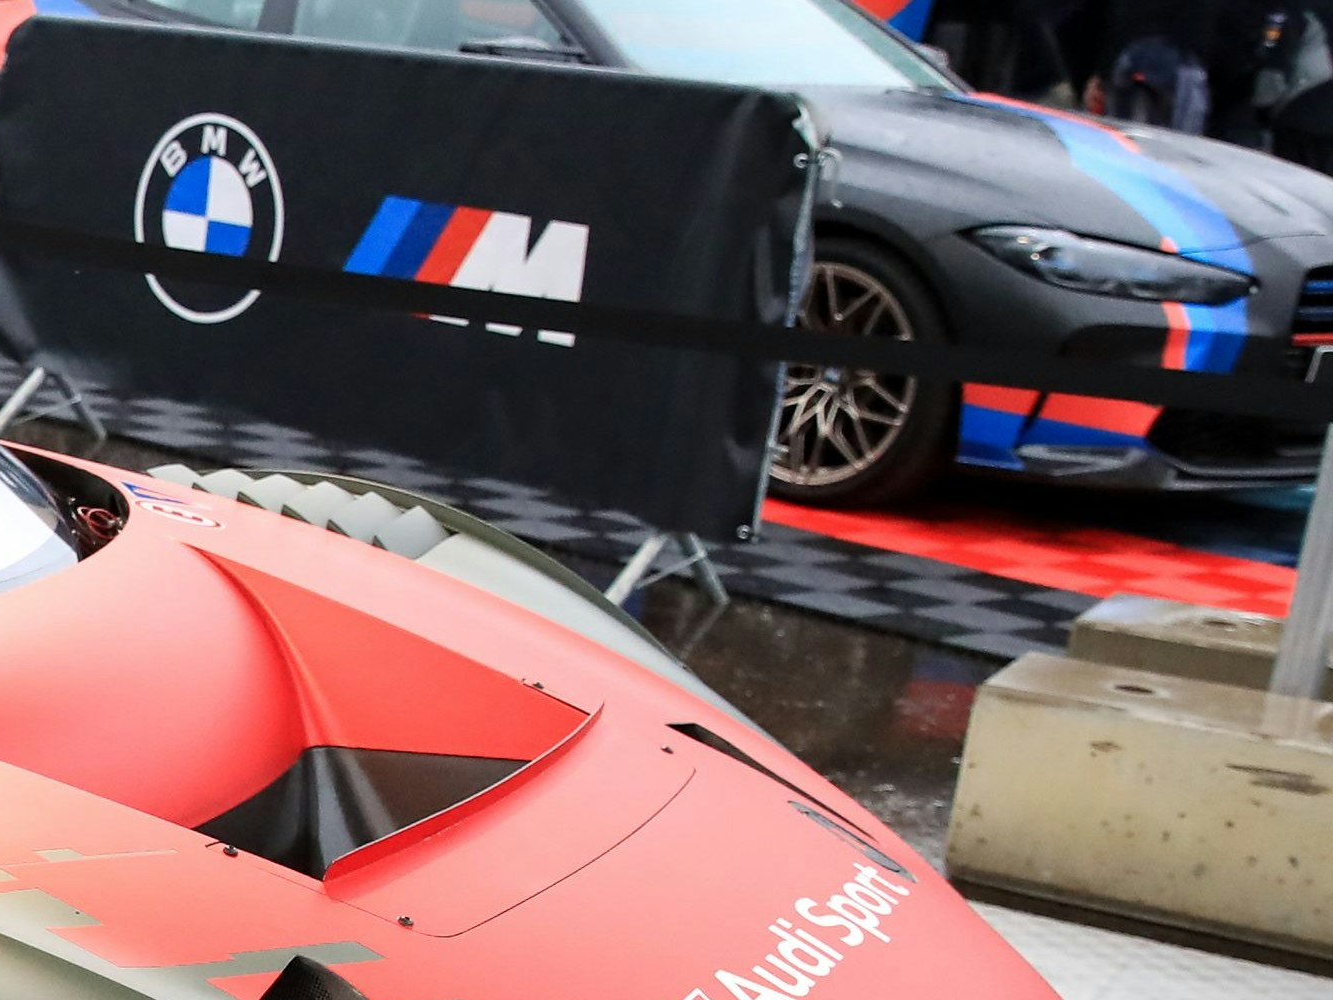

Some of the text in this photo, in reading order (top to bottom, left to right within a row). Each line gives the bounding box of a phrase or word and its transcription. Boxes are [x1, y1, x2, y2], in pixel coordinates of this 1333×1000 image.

[160, 125, 270, 187] BMW
[429, 210, 590, 347] M
[794, 862, 910, 945] Sport
